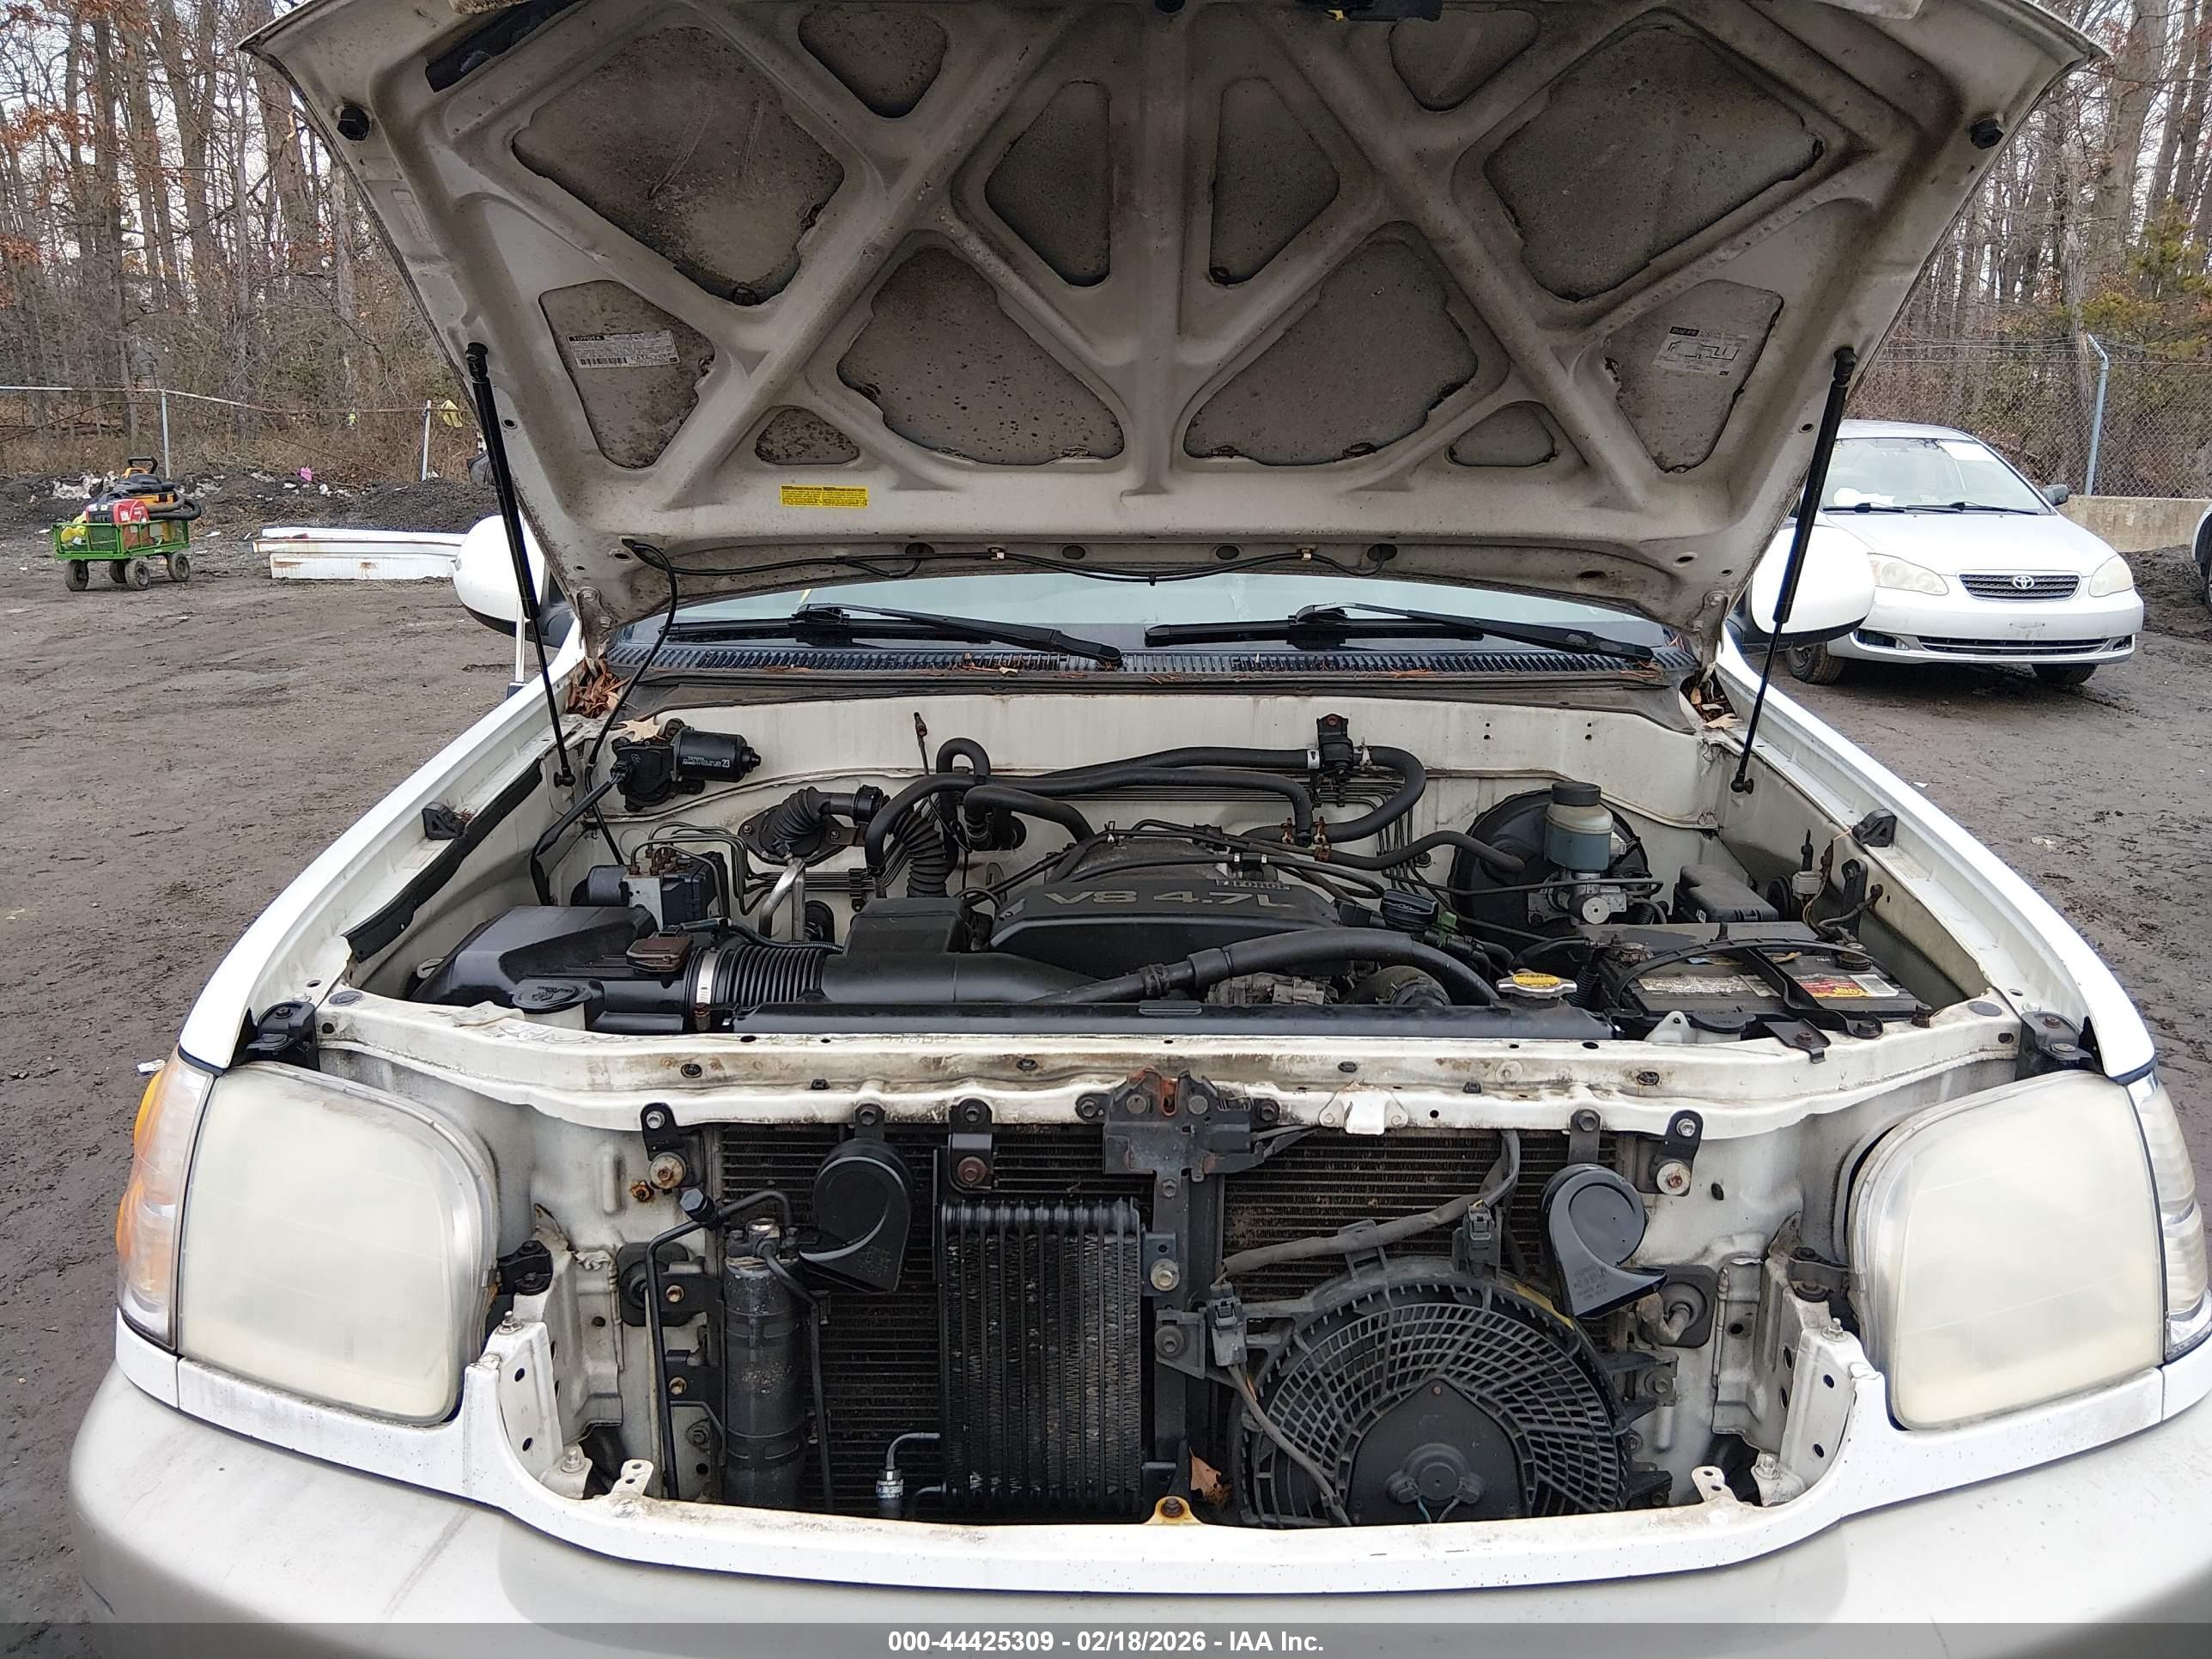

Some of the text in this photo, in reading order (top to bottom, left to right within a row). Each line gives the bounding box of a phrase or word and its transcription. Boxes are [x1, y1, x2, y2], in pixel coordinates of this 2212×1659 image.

[721, 759, 730, 768] 23
[1044, 890, 1295, 908] V8 4.7L
